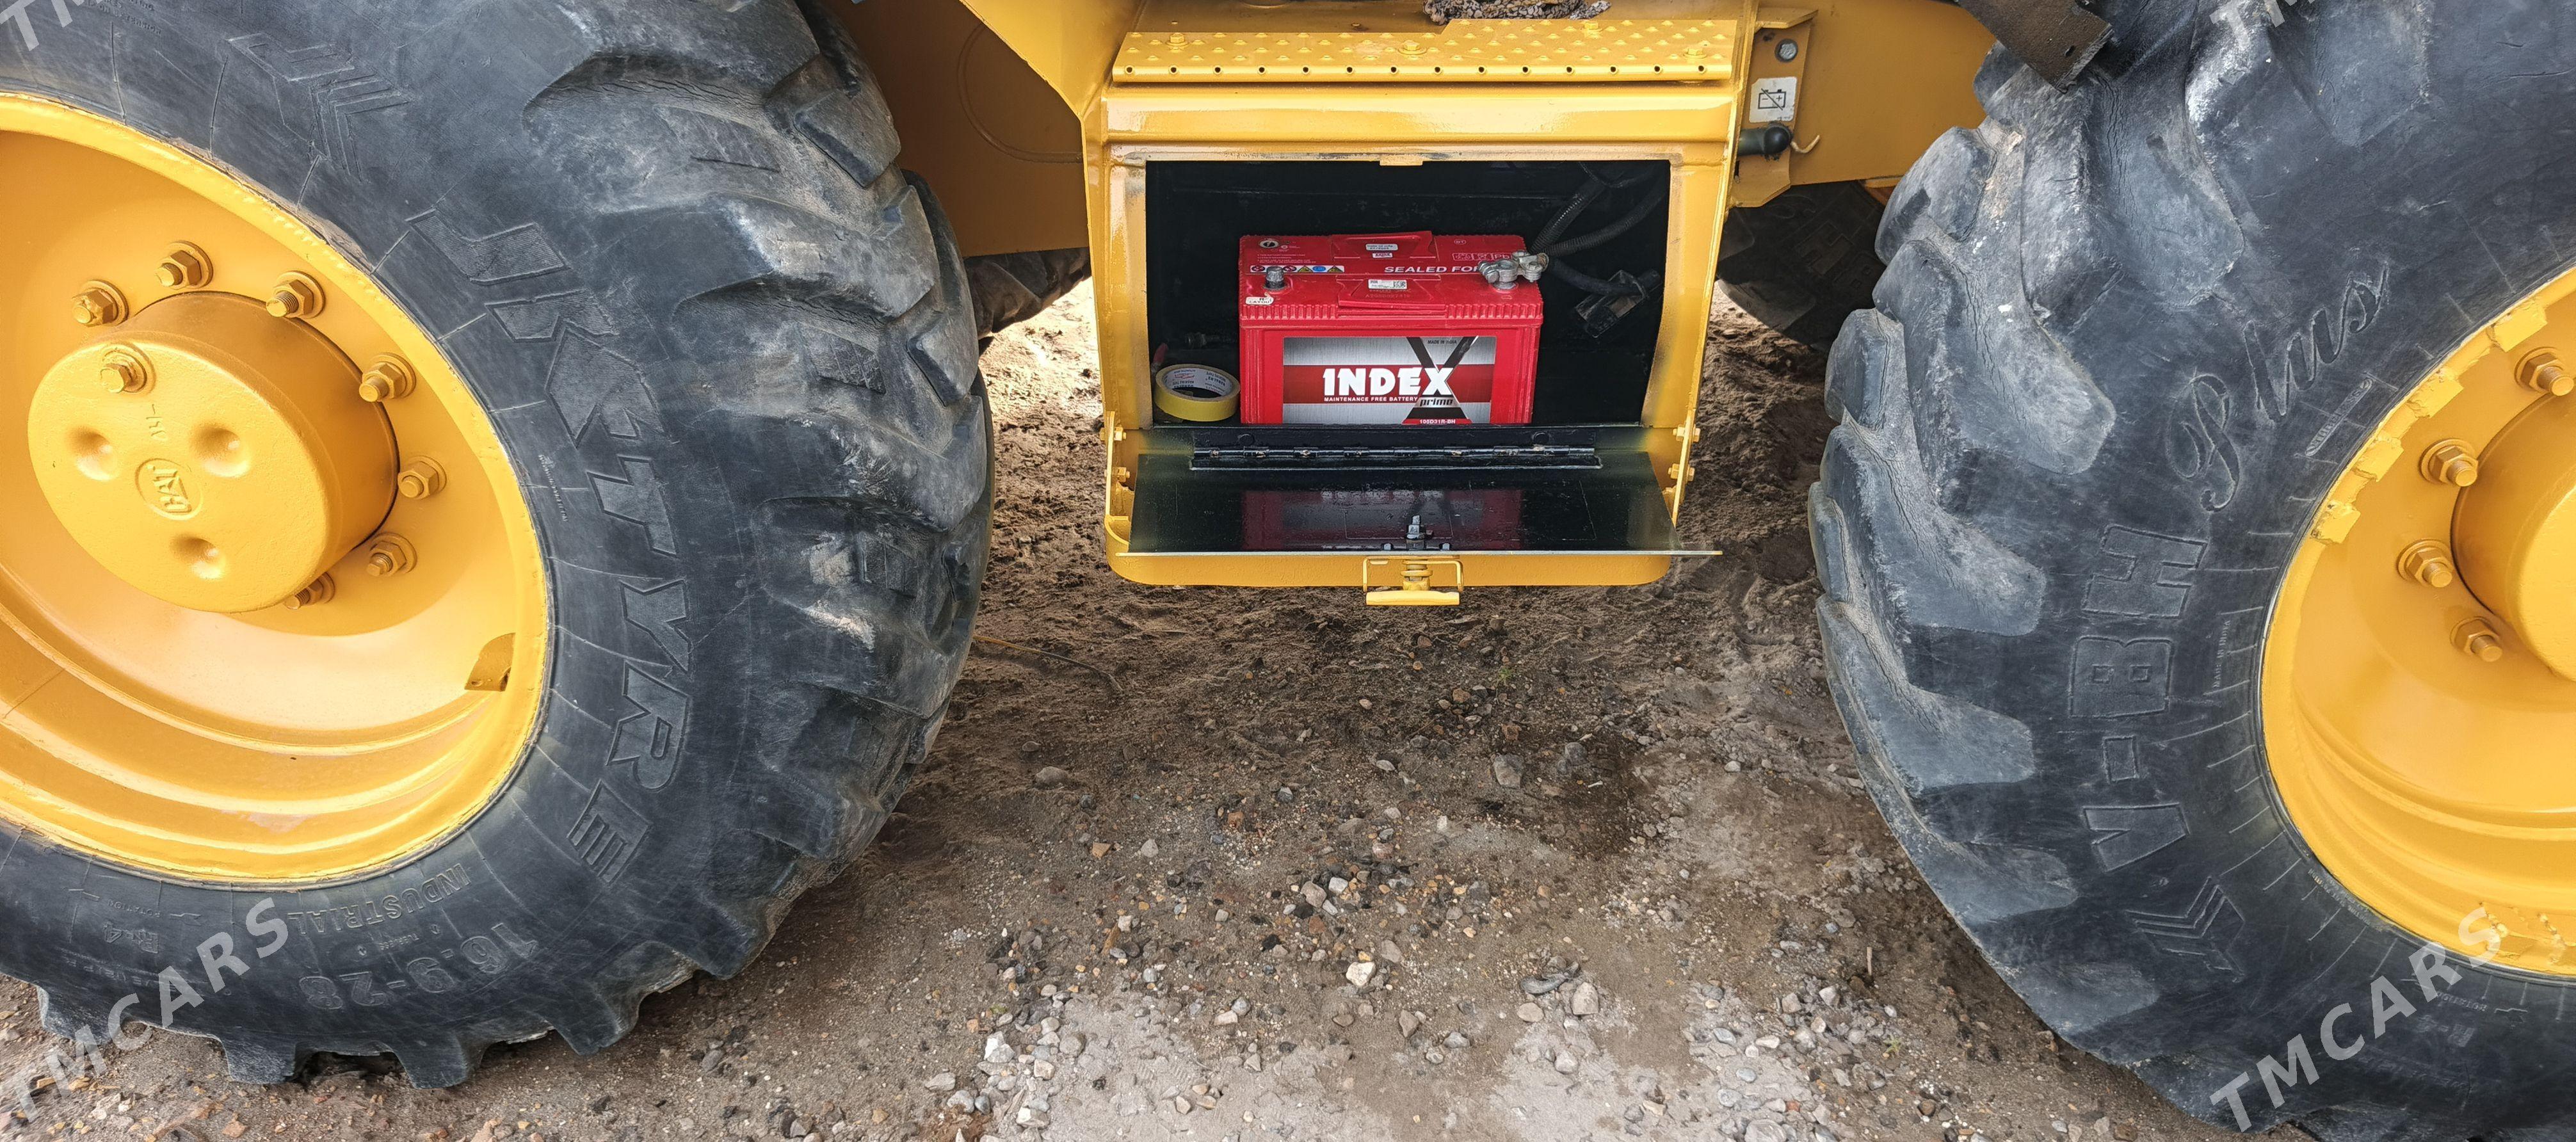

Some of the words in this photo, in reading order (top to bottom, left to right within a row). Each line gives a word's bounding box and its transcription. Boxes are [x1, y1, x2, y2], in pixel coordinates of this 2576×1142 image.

[1323, 367, 1454, 396] INDEX
[1419, 398, 1454, 407] prime
[2166, 259, 2390, 512] Plus
[405, 209, 672, 448] JK
[567, 454, 693, 885] TYRE
[2068, 524, 2210, 872] V-BH
[101, 921, 159, 954] R-4
[287, 862, 471, 935] INDUSTRIAL
[298, 922, 538, 1009] 16.9-28
